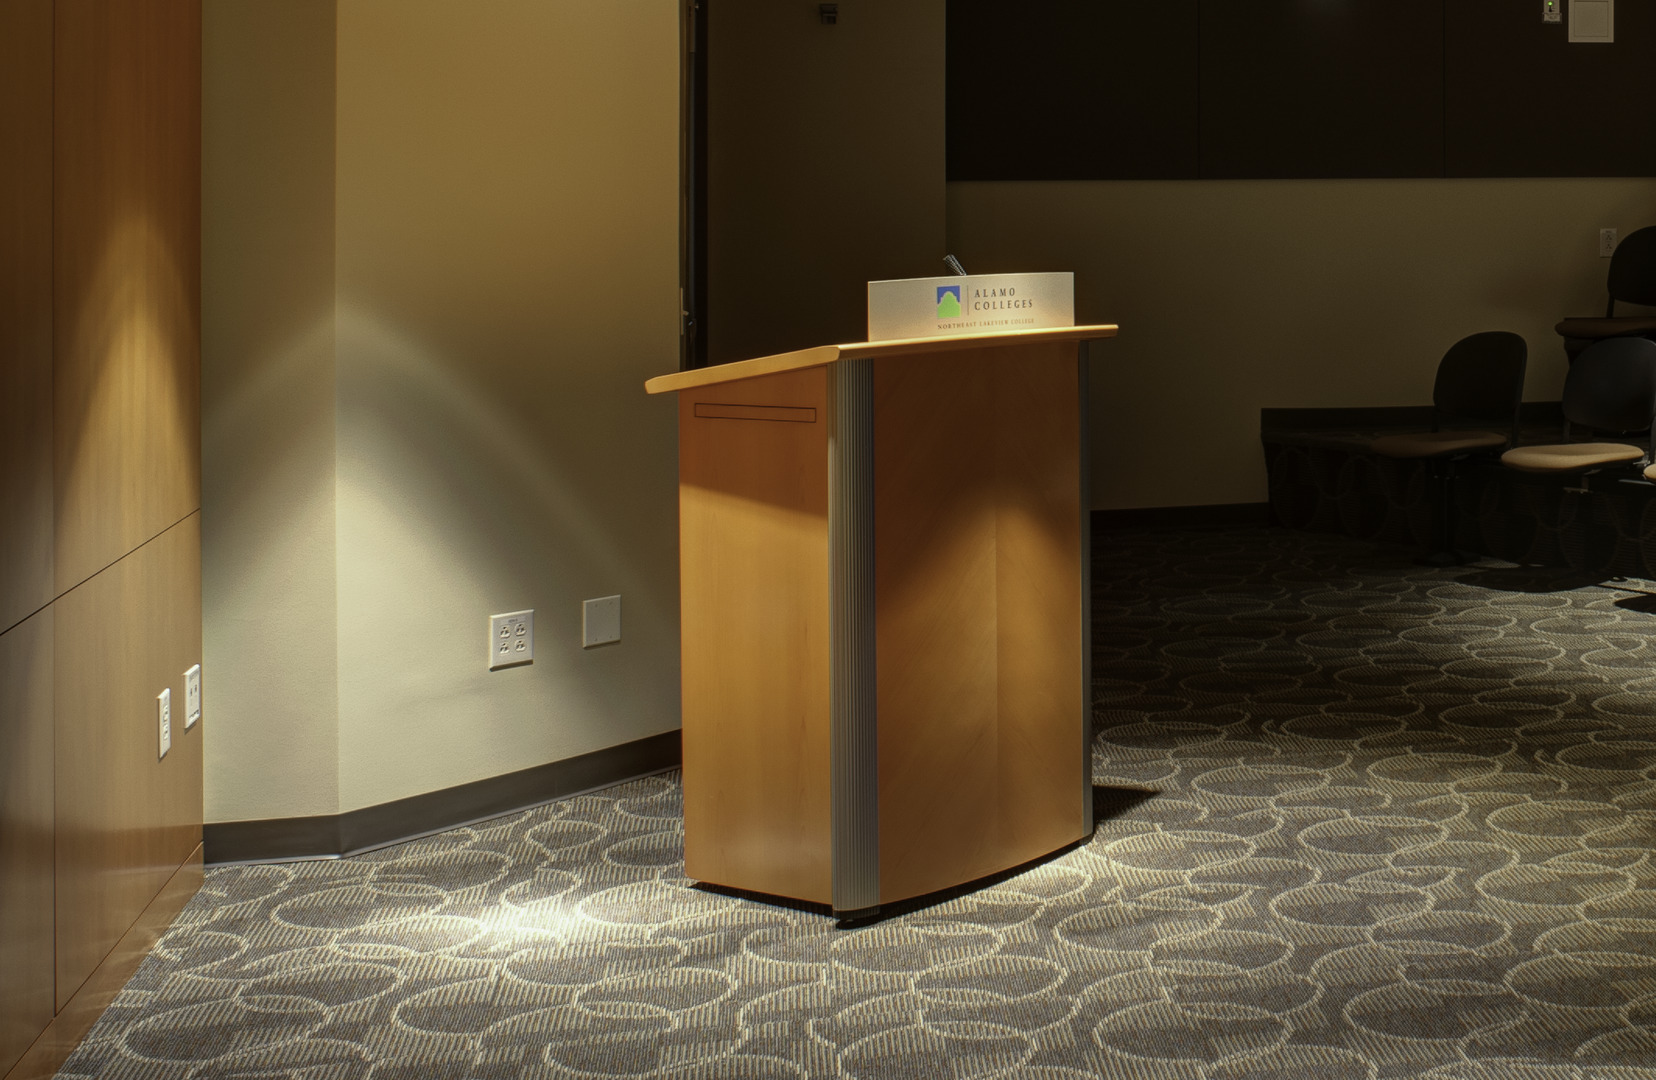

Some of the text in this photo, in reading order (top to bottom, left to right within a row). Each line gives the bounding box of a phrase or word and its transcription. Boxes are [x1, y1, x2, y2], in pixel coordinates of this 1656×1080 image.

[974, 287, 1016, 298] ALAMO
[974, 299, 1033, 311] COLLEGES
[937, 317, 1035, 330] NORTHEAST LAKEVIEW COLLEGE
